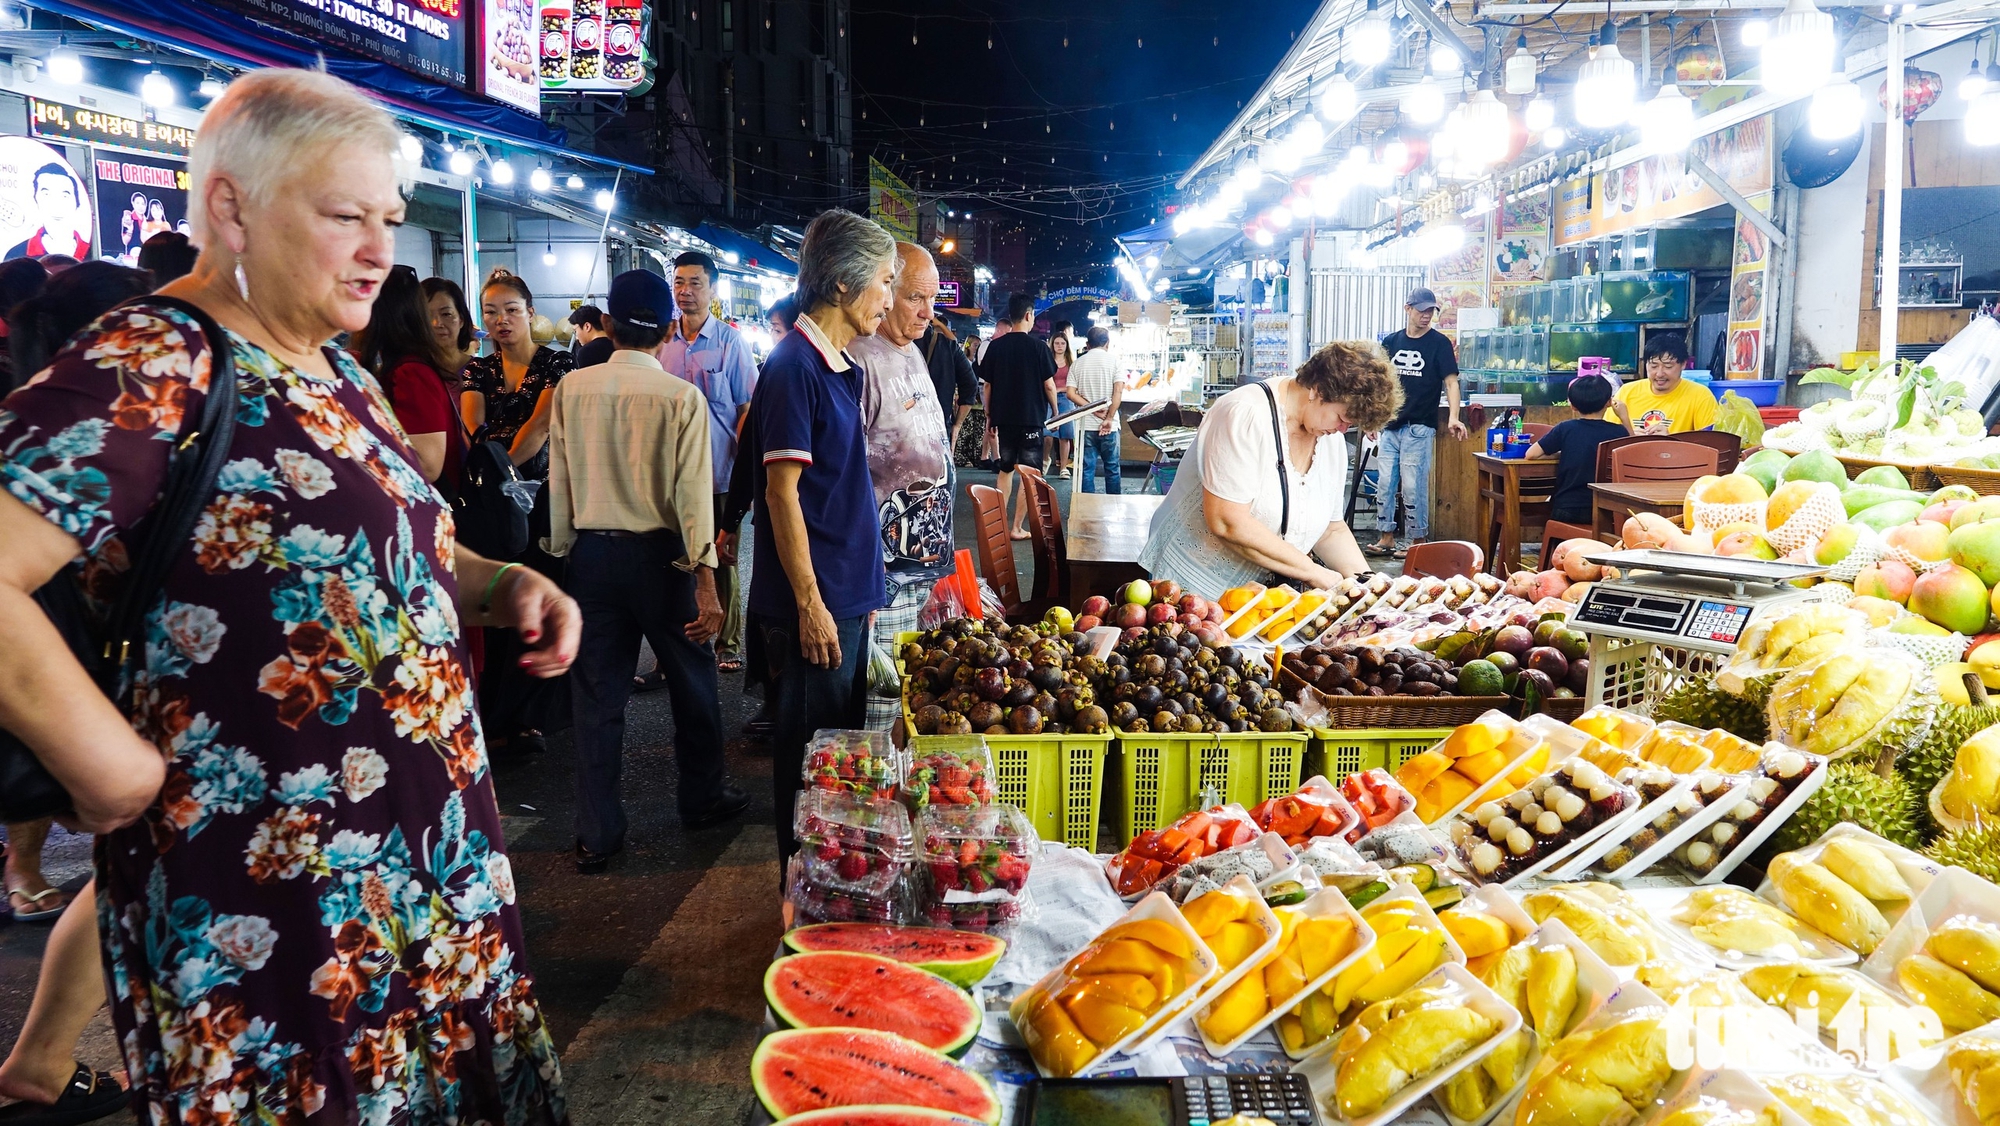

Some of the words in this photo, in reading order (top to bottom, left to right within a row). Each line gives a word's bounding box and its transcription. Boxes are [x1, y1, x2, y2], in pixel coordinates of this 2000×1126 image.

[270, 1, 292, 21] KP2,
[365, 37, 380, 52] PHÚ
[334, 0, 407, 43] 1701538221
[397, 2, 450, 41] FLAVORS
[0, 163, 19, 175] HOU
[96, 159, 122, 183] THE
[121, 163, 178, 190] ORIGINAL
[0, 178, 19, 189] UOC
[1066, 285, 1082, 295] ĐÊM
[1083, 285, 1098, 295] PHÚ
[888, 375, 911, 400] I'M
